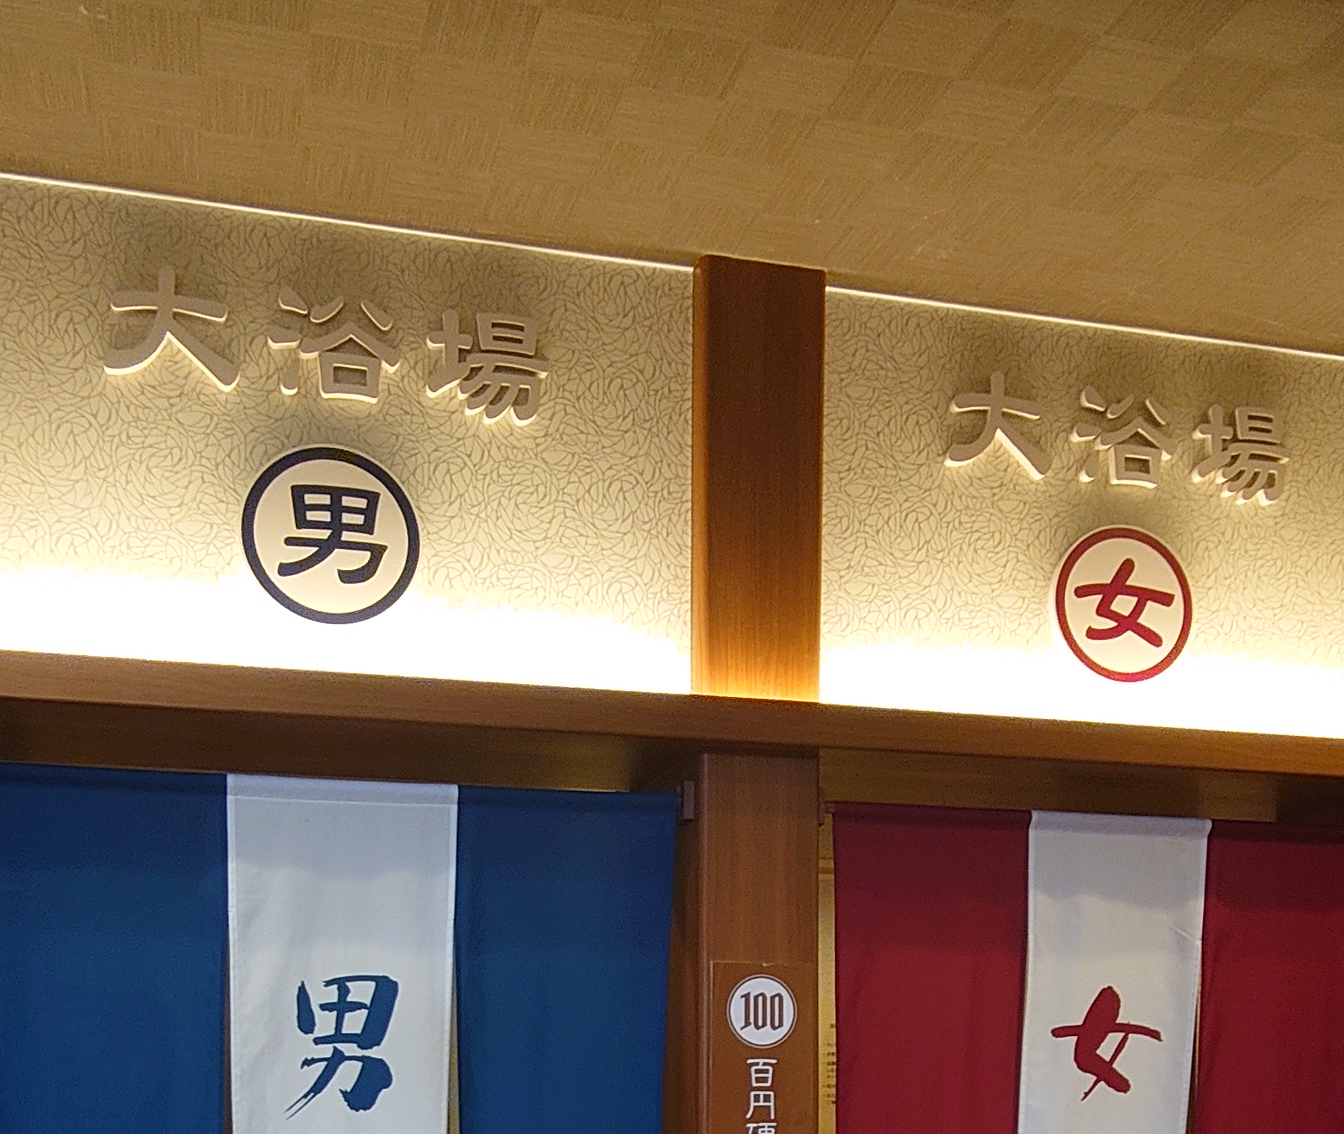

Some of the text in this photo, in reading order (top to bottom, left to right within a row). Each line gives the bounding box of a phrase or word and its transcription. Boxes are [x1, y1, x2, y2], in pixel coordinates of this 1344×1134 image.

[103, 267, 548, 427] 大浴場
[944, 372, 1290, 505] 大浴場
[277, 484, 388, 585] 男
[1074, 557, 1175, 647] 女
[740, 991, 785, 1032] 100
